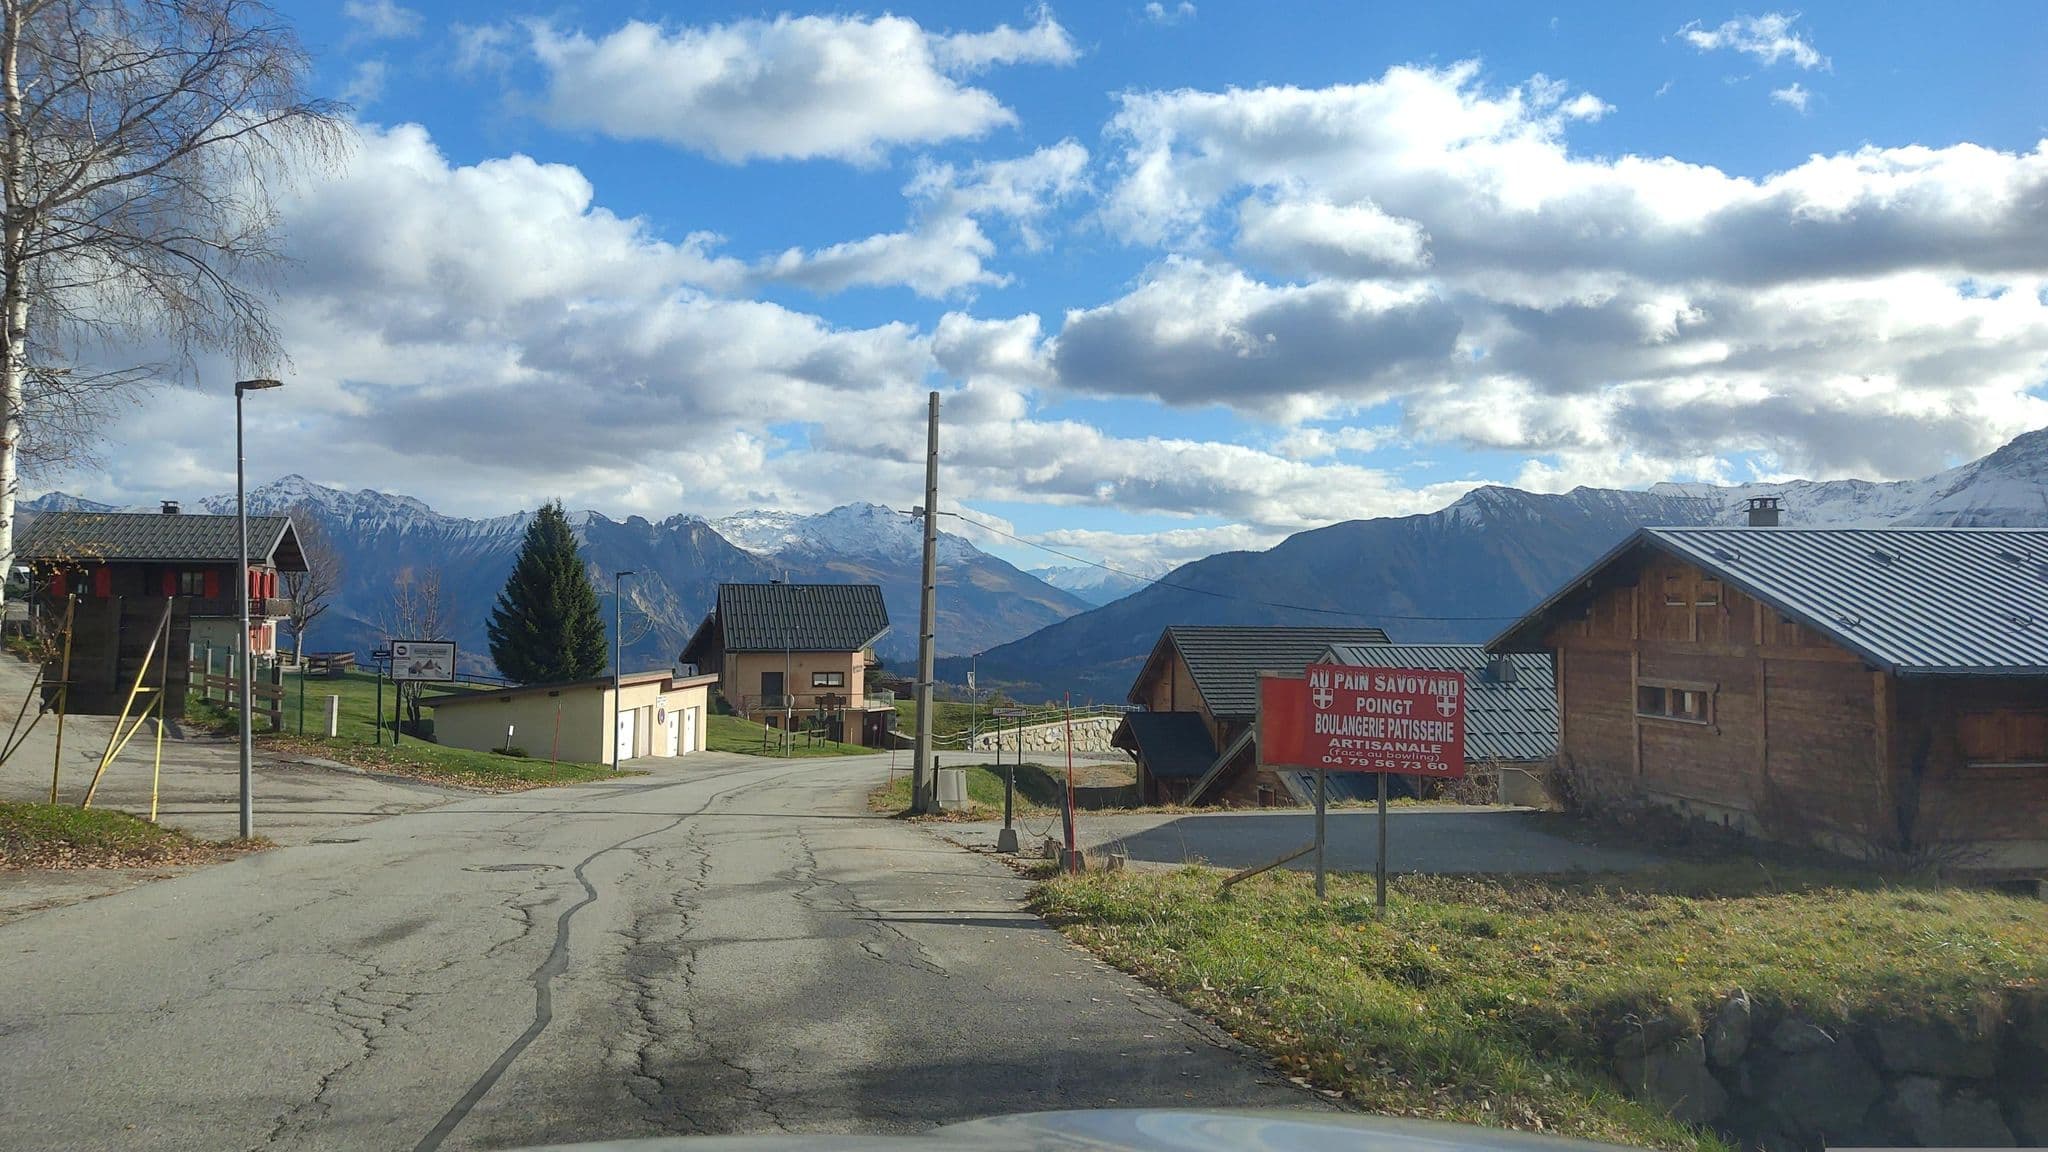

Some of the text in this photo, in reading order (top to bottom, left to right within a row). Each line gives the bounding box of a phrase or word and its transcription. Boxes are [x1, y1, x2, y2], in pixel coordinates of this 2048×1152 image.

[1309, 669, 1459, 696] AU PAIN SAVOYARD
[1357, 697, 1413, 715] POINGT
[1315, 713, 1454, 742] BOULANGERIE PATISSERIE
[1328, 738, 1442, 754] ARTISANALE
[1322, 755, 1449, 771] 04 79 56 73 60
[1329, 748, 1364, 757] (face
[1386, 751, 1440, 762] bowling)
